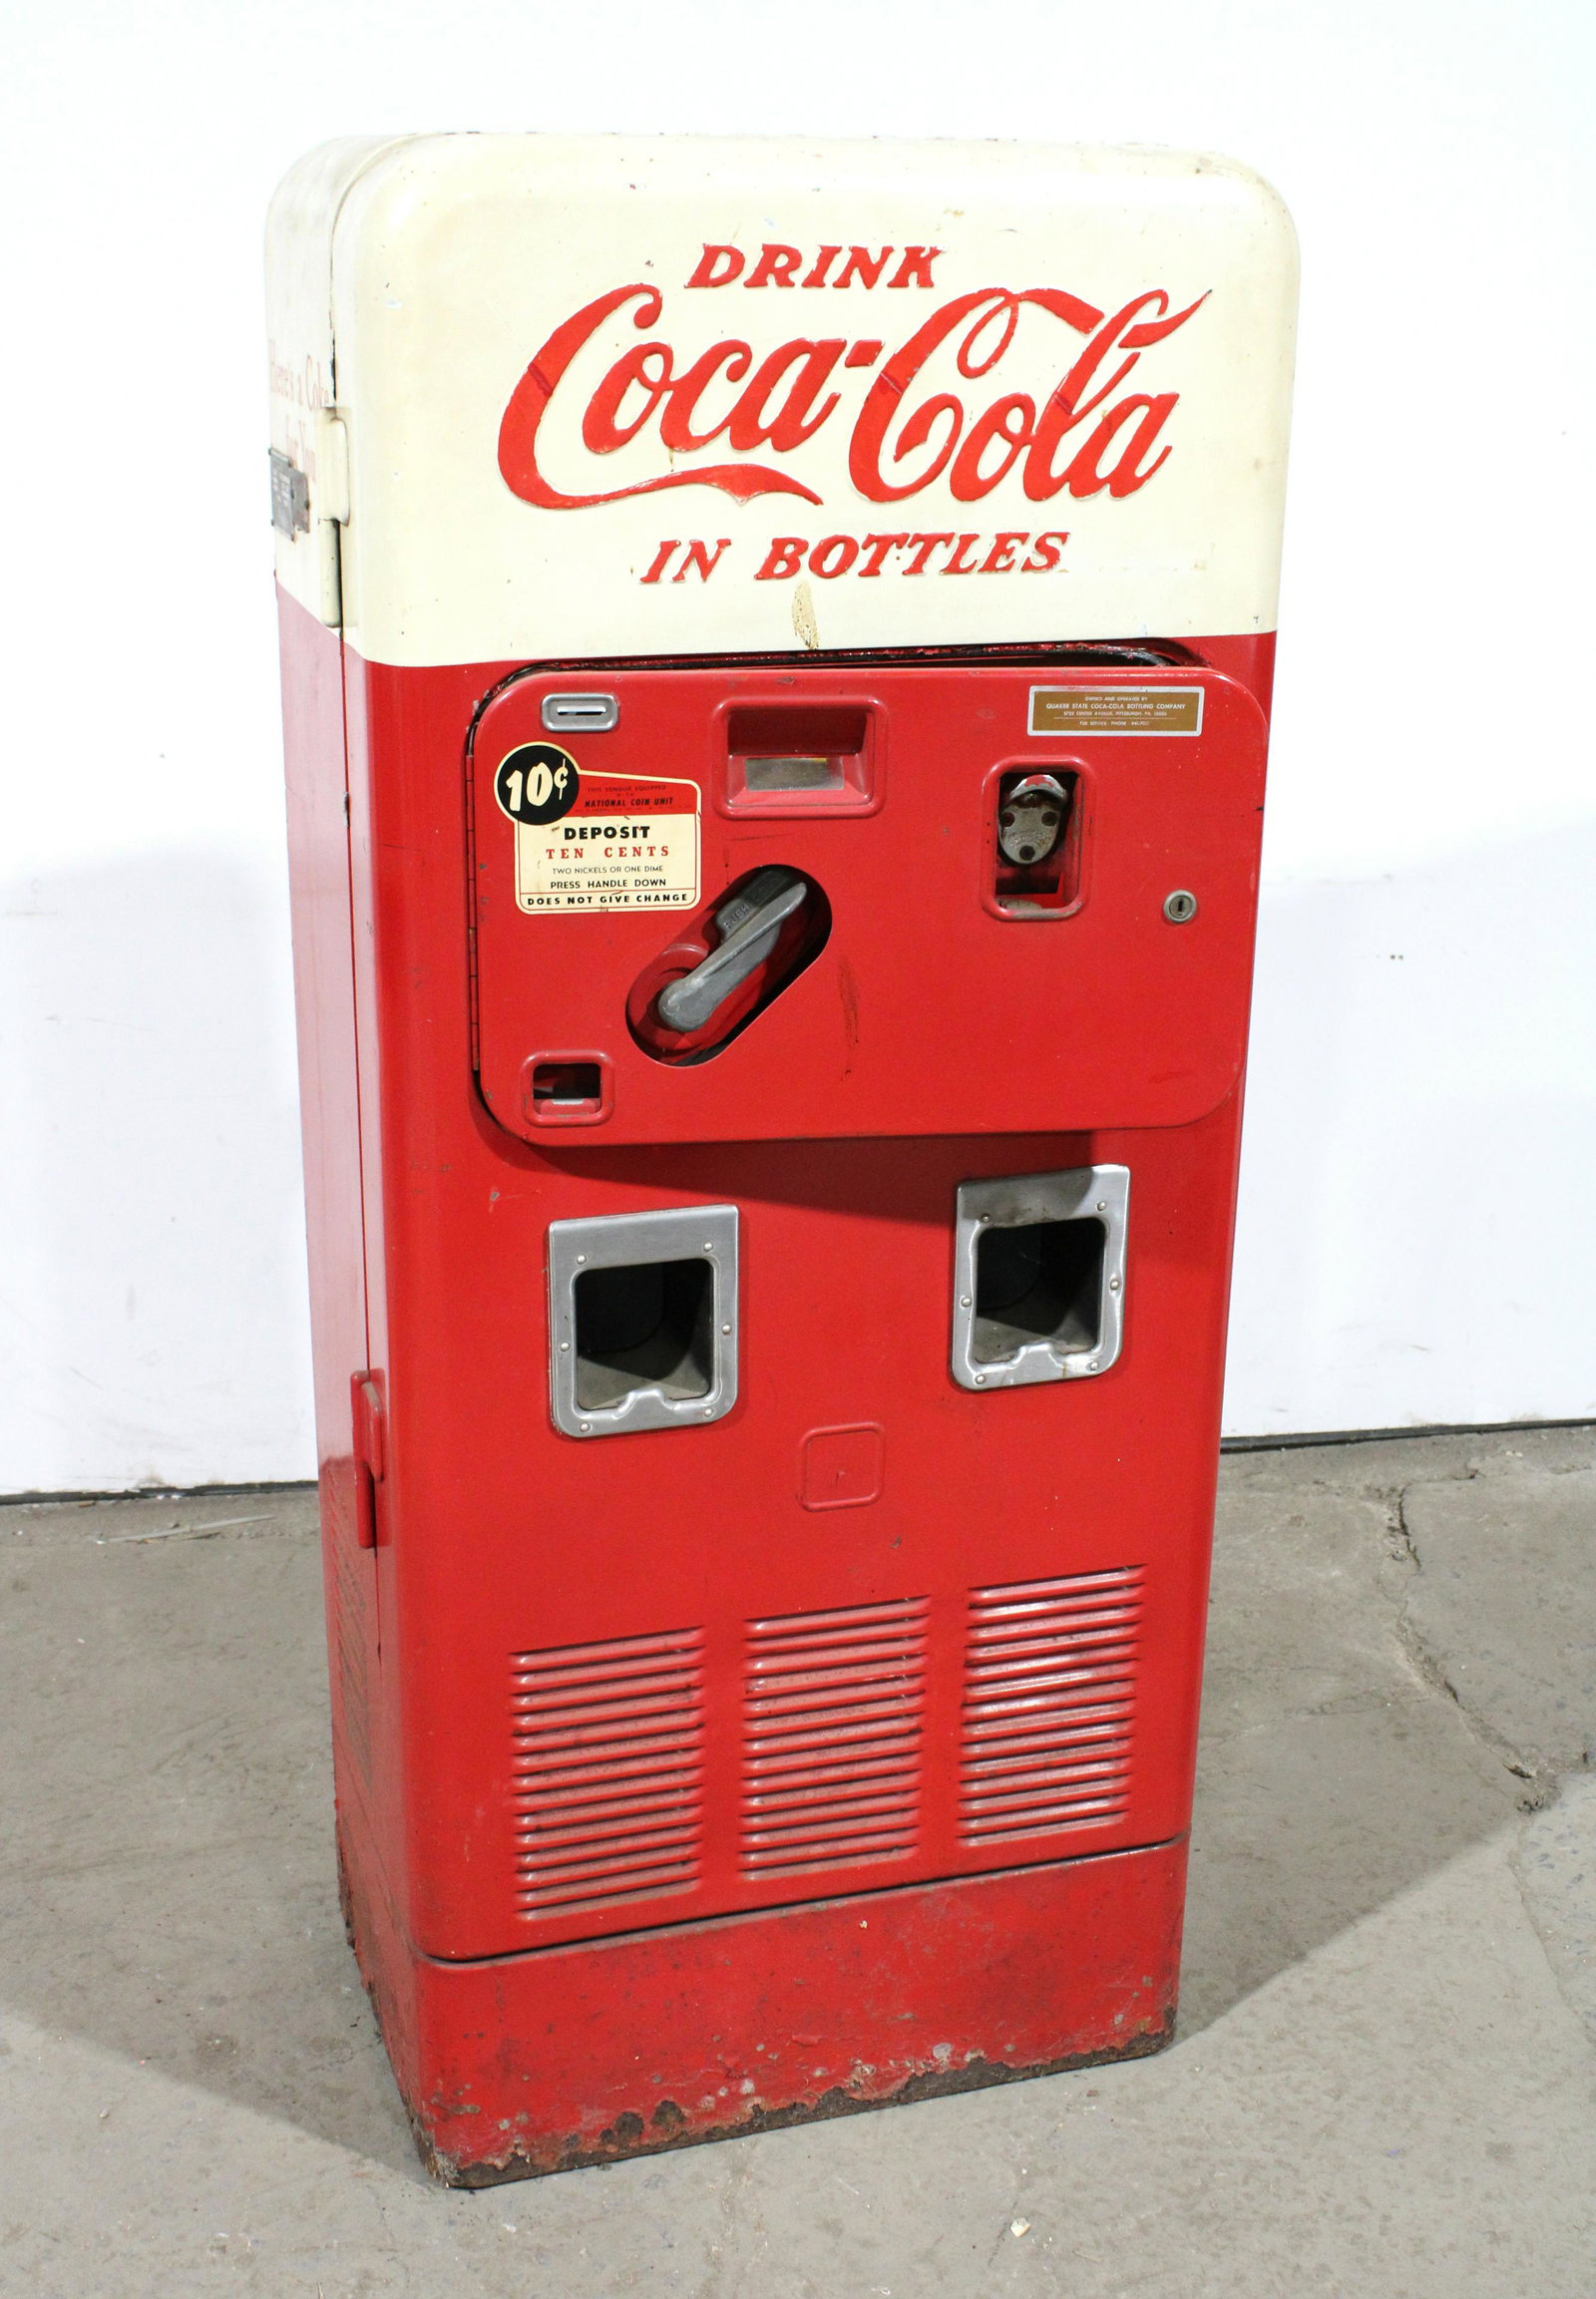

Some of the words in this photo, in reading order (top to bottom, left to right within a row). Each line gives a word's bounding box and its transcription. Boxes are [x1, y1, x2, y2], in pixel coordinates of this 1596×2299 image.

[684, 242, 946, 289] DRINK
[497, 282, 1213, 511] Coca-Cola
[639, 539, 732, 584] IN
[753, 531, 1070, 581] BOTTLES
[506, 758, 569, 812] 10¢
[585, 798, 625, 808] NATIONAL
[630, 798, 650, 807] COIN
[654, 797, 673, 806] UNIT
[564, 826, 650, 840] DEPOSIT
[546, 848, 584, 860] TEN
[603, 846, 669, 858] CENTS
[551, 881, 581, 890] PRESS
[588, 880, 628, 889] HANDLE
[634, 879, 666, 888] DOWN
[528, 897, 561, 906] DOES
[567, 896, 593, 905] NOT
[599, 895, 629, 904] GIVE
[636, 893, 688, 903] CHANGE
